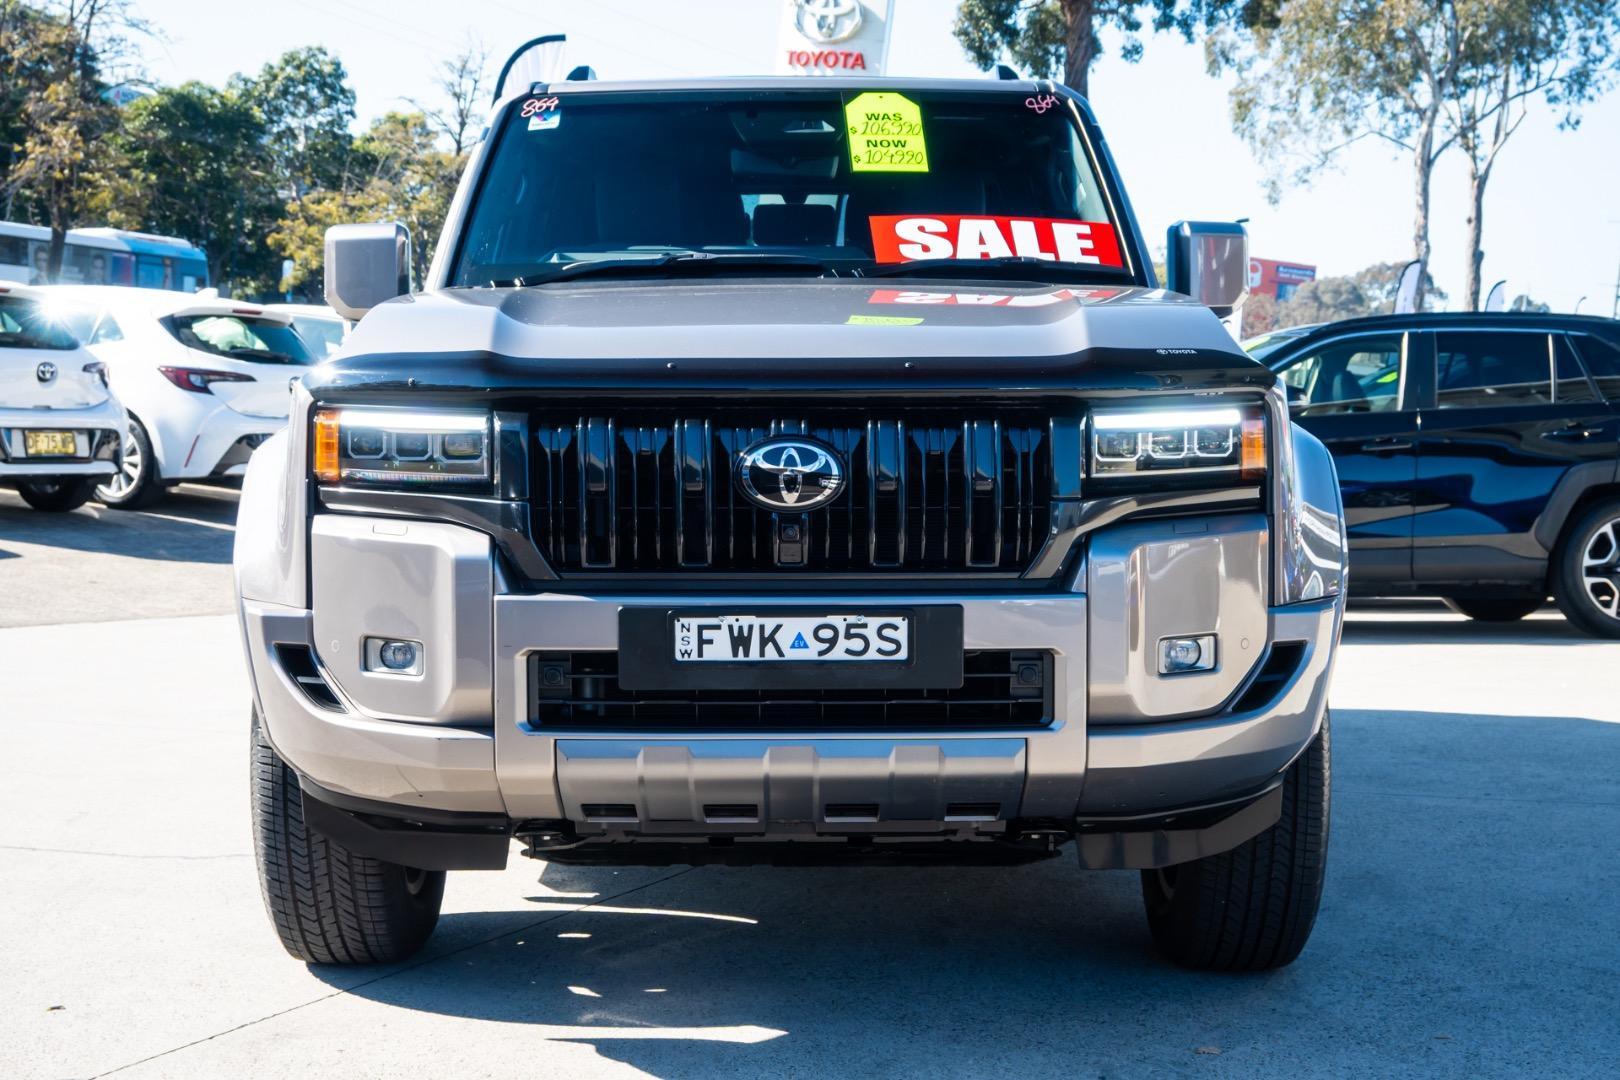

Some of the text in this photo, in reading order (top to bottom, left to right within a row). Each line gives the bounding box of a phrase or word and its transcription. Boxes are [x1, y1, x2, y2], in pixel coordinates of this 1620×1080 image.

[786, 50, 866, 70] TOYOTA
[521, 96, 559, 117] 864
[865, 113, 902, 121] WAS
[866, 139, 907, 148] NOW
[895, 218, 1100, 264] SALE
[697, 623, 786, 659] FWK
[812, 622, 902, 658] 95S
